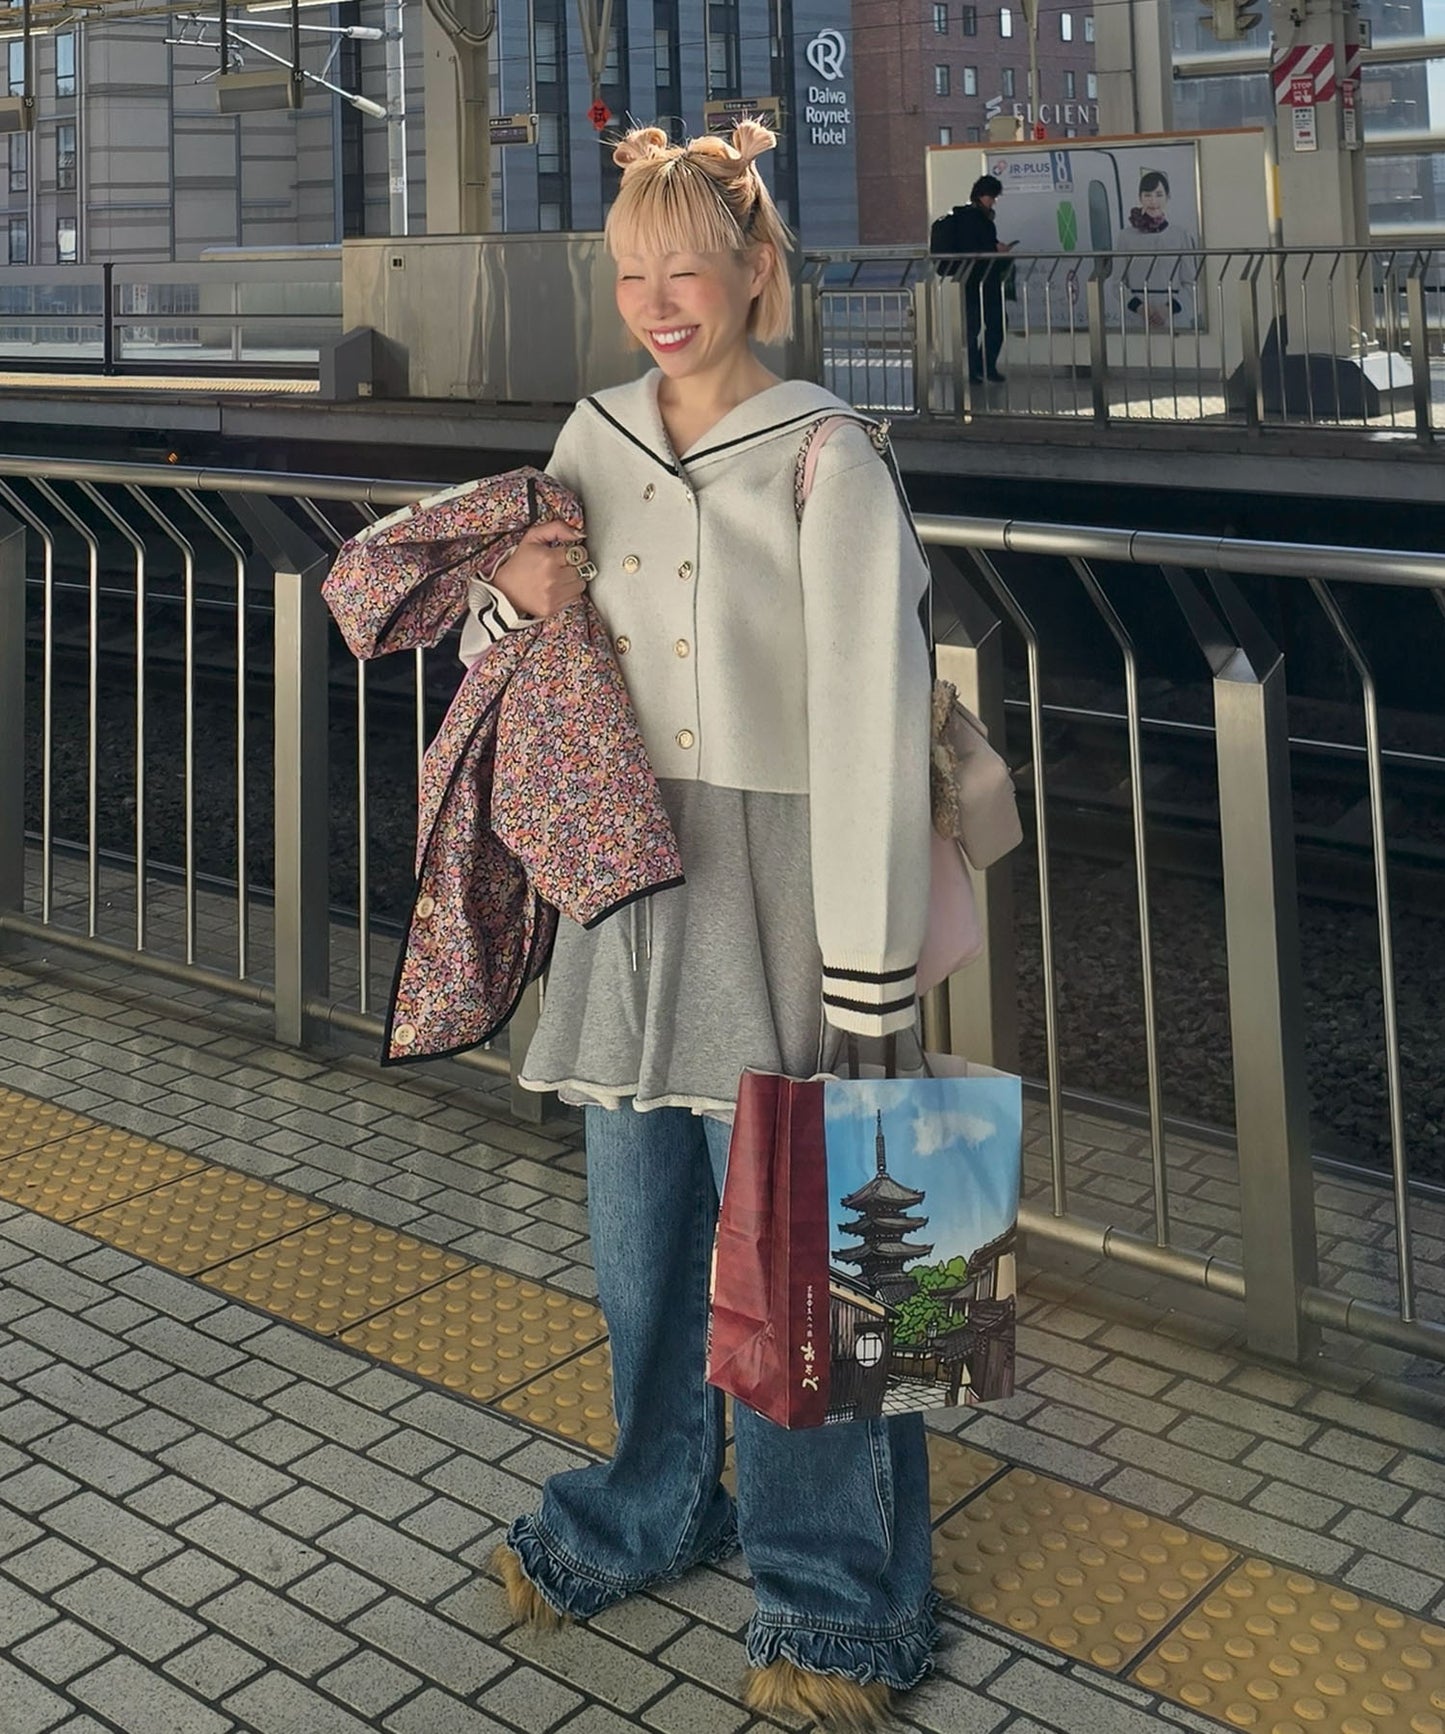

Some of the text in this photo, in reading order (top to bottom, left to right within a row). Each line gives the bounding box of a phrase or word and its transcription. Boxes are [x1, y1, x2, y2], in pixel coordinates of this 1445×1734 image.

[809, 86, 846, 104] Daiwa
[1292, 82, 1312, 90] STOP
[806, 106, 851, 128] Roynet
[812, 127, 846, 145] Hotel
